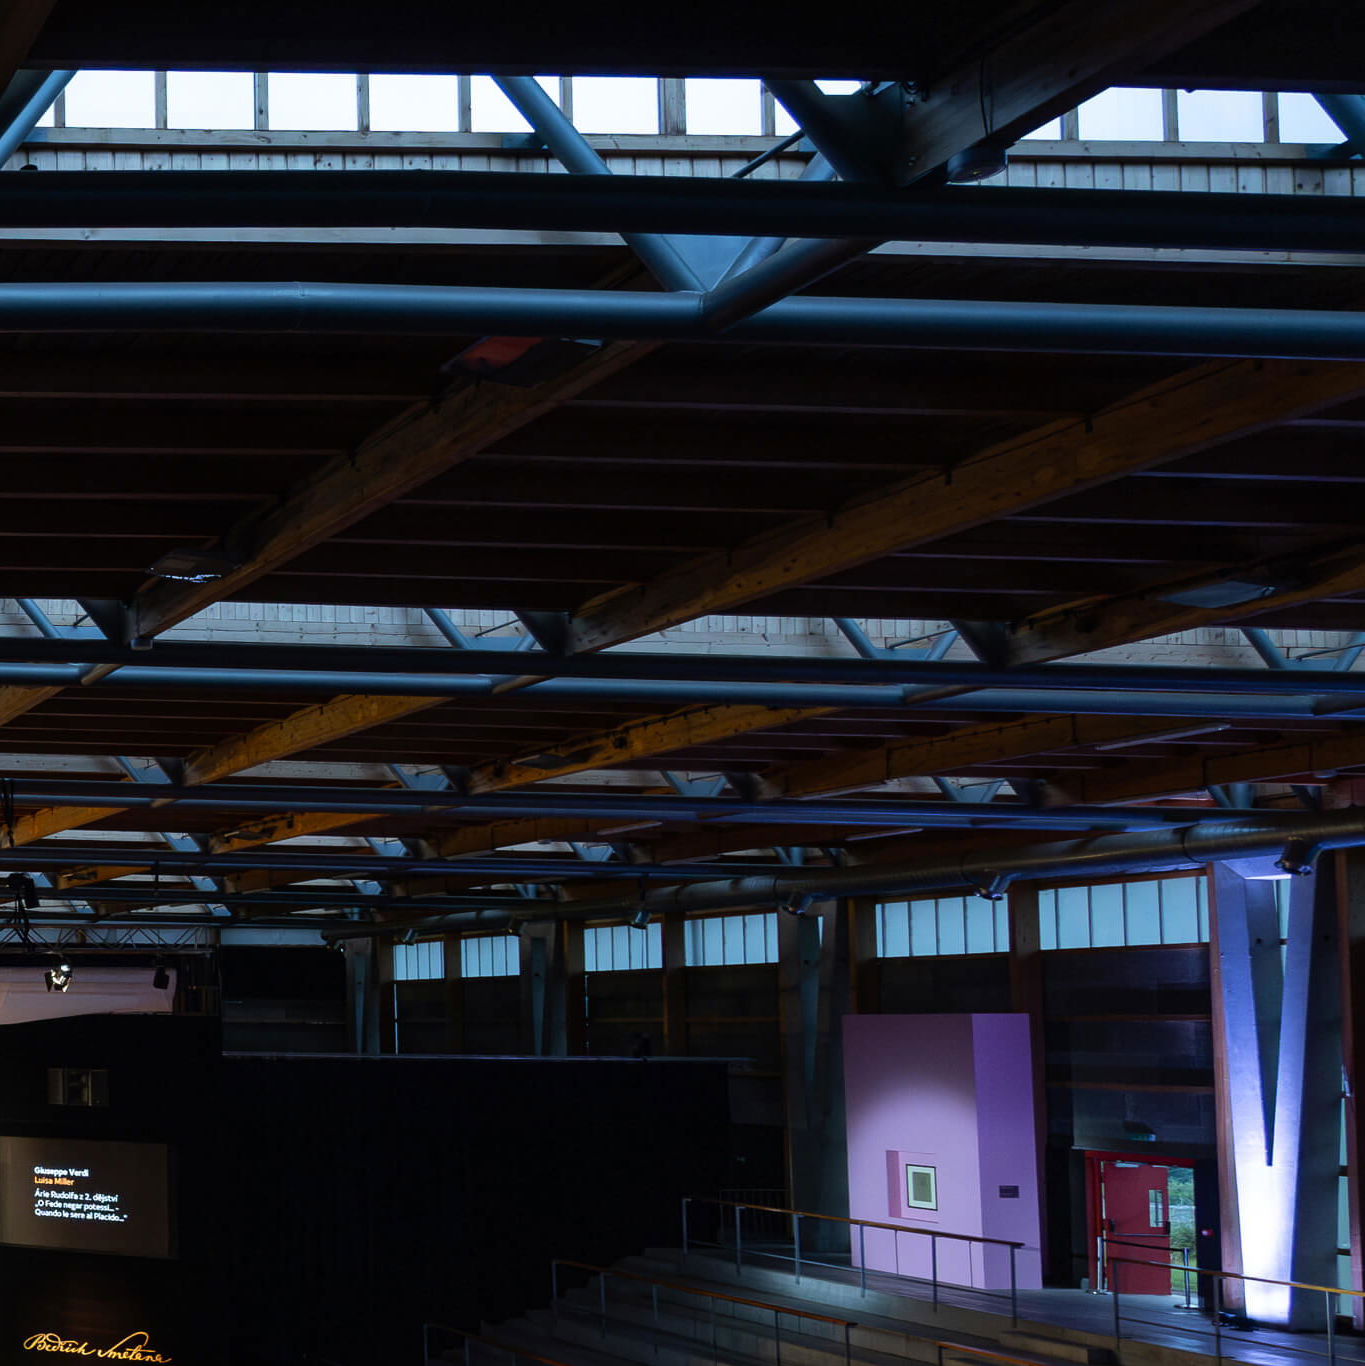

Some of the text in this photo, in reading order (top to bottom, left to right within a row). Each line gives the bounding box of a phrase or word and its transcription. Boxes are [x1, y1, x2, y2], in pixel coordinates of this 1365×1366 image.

[34, 1167, 88, 1177] Giuseppe Verdi
[34, 1176, 75, 1186] Luisa Miller
[51, 1191, 78, 1199] Rudolfa
[45, 1200, 62, 1208] Fede
[35, 1209, 62, 1218] Quando
[87, 1211, 92, 1219] al
